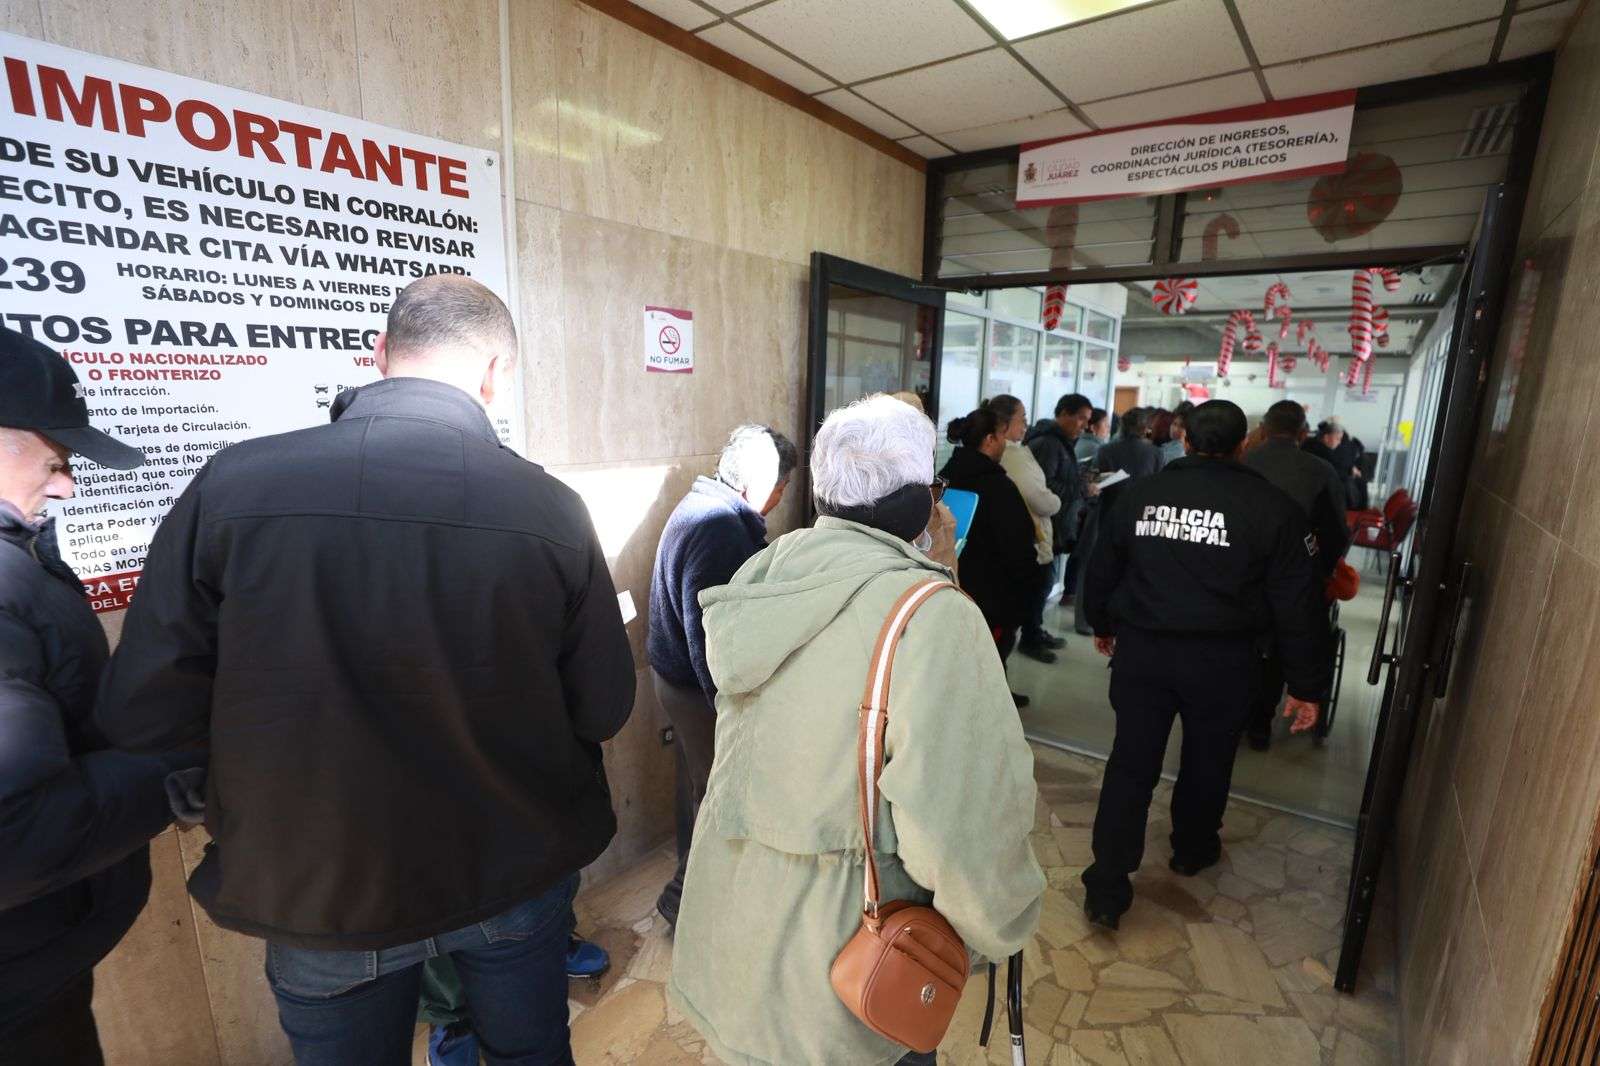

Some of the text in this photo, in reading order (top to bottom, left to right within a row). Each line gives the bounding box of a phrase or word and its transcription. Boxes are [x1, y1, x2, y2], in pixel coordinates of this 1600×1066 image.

[4, 56, 469, 199] IMPORTANTE
[1130, 124, 1289, 156] DIRECCIÓN DE INGRESOS,
[1090, 153, 1180, 174] COORDINACIÓN
[1183, 146, 1242, 162] JURÍDICA
[1246, 131, 1338, 154] (TESORERÍA),
[1127, 152, 1287, 181] ESPECTÁCULOS PÚBLICOS
[0, 136, 479, 234] DE SU VEHÍCULO EN CORRALÓN:
[0, 175, 476, 258] ECITO, ES NECESARIO REVISAR
[0, 213, 191, 256] AGENDAR
[200, 236, 273, 264] CITA
[279, 244, 330, 269] VÍA
[116, 262, 227, 285] HORARIO:
[233, 272, 297, 290] LUNES
[302, 278, 315, 292] A
[319, 280, 391, 297] VIERNES
[142, 284, 390, 314] SÁBADOS Y DOMINGOS DE
[0, 312, 112, 345] TOS
[124, 318, 238, 347] PARA
[130, 352, 268, 366] NACIONALIZADO
[649, 355, 689, 365] NO FUMAR
[88, 368, 221, 381] O FRONTERIZO
[100, 385, 170, 397] infracción.
[121, 405, 138, 416] de
[142, 404, 219, 417] Importación.
[115, 425, 160, 437] Tarjeta
[163, 422, 178, 433] de
[182, 420, 252, 432] Circulación.
[165, 443, 180, 453] de
[142, 456, 179, 468] entes
[182, 454, 203, 466] (No
[142, 469, 165, 481] que
[80, 481, 174, 498] identificación.
[62, 498, 155, 517] Identificación
[66, 522, 104, 534] Carta
[108, 517, 147, 529] Poder
[1135, 520, 1231, 547] MUNICIPAL
[72, 542, 151, 561] Todo en ori
[91, 597, 123, 610] DEL
